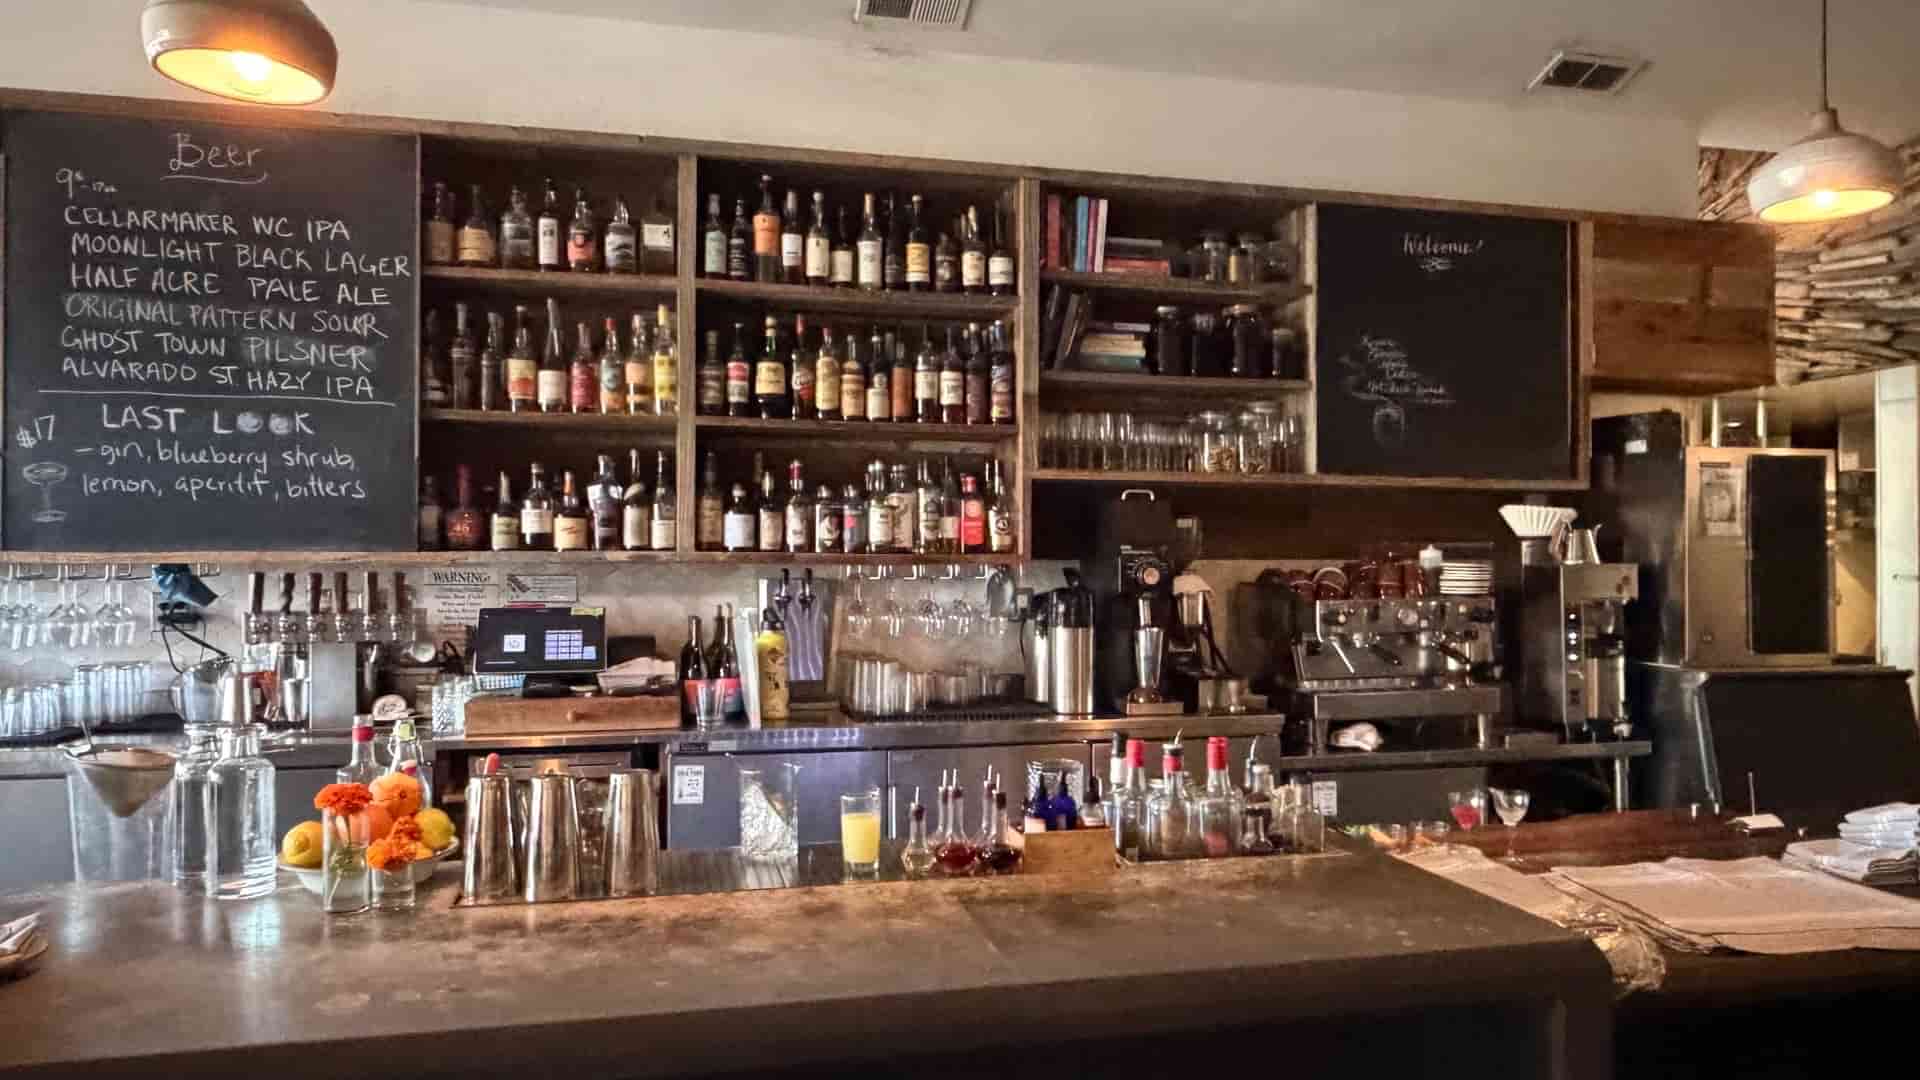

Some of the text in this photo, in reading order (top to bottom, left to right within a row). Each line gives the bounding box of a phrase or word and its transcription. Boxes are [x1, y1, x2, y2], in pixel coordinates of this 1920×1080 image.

[169, 133, 260, 171] Beer
[64, 206, 351, 243] CELLARMAKER WC IPA
[72, 232, 411, 277] MOONLIGHT BLACK LAGER
[72, 262, 391, 307] HALF ACRE PALE ALE
[65, 293, 389, 338] ORIGINAL PATTERN SOUR
[61, 325, 374, 373] GHOST TOWN PILSNER
[62, 357, 197, 382] ALVARADO
[248, 370, 311, 391] HAZY
[326, 375, 374, 399] IPA
[16, 414, 55, 448] $17
[102, 404, 187, 433] LAST
[157, 439, 268, 475] blueberry
[83, 474, 163, 497] lemon,
[286, 474, 367, 498] bitters
